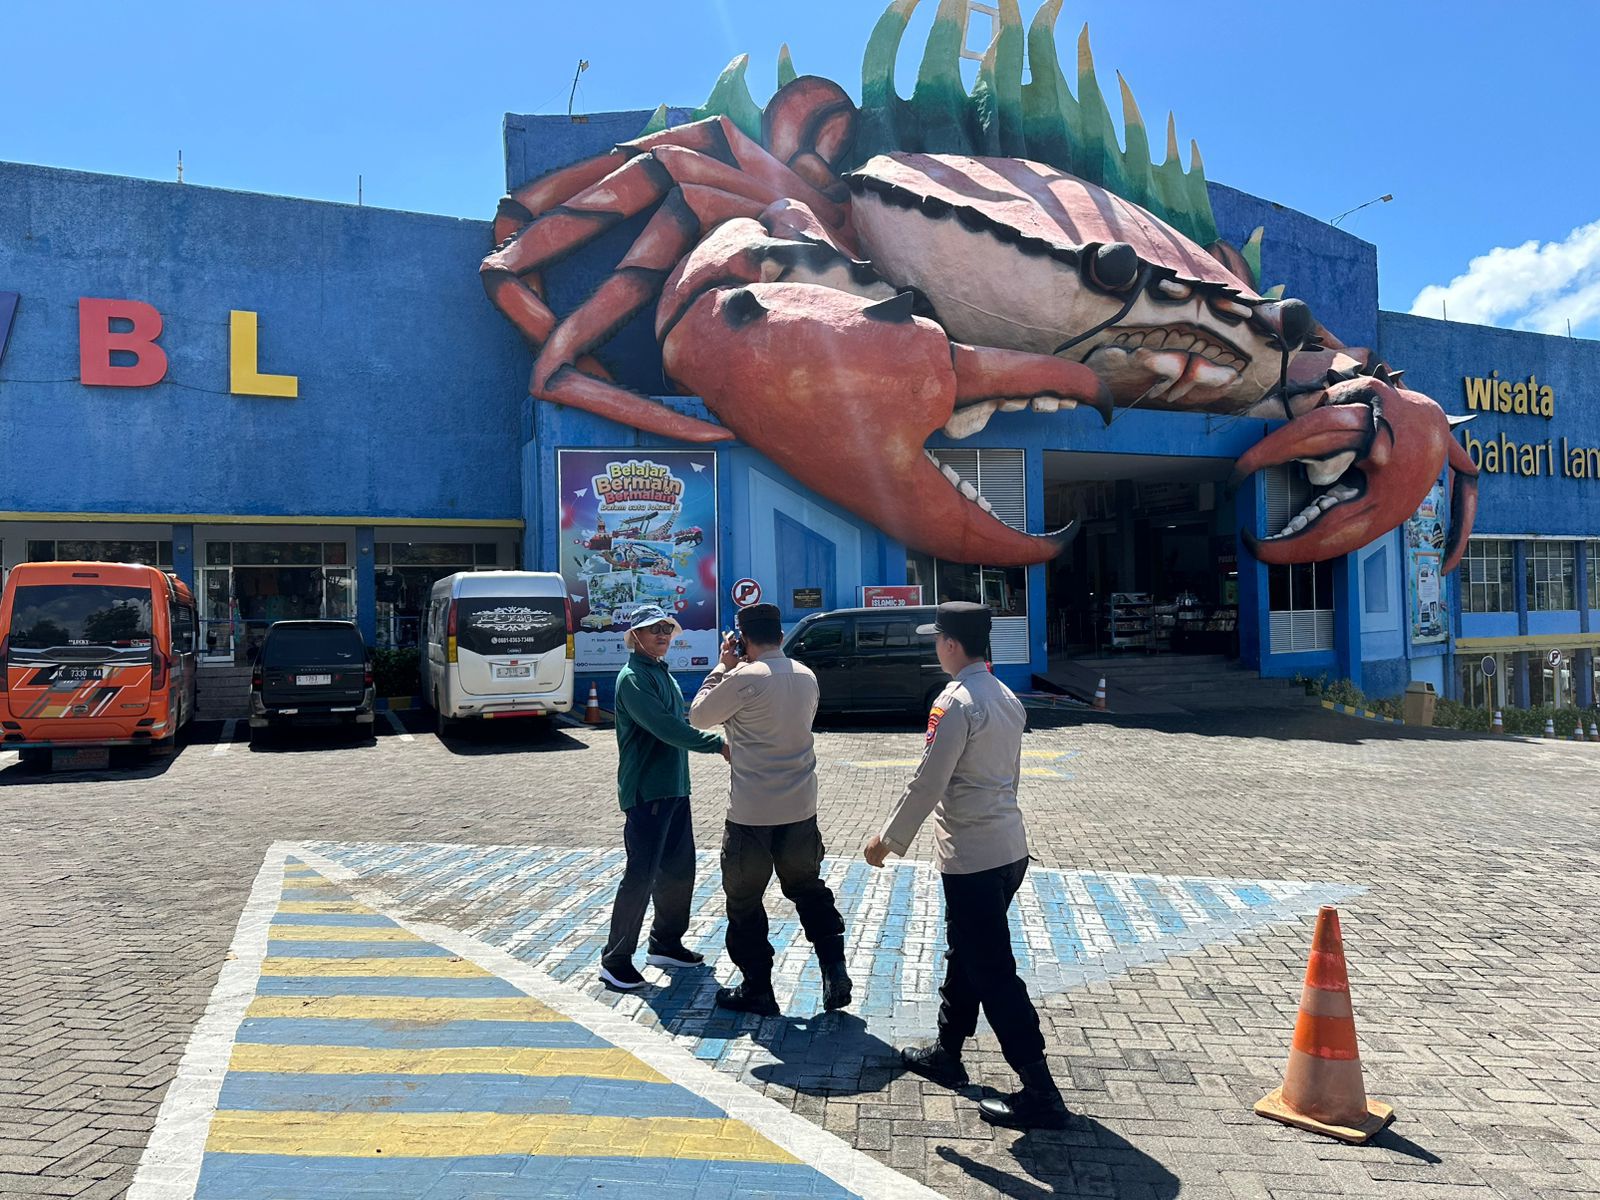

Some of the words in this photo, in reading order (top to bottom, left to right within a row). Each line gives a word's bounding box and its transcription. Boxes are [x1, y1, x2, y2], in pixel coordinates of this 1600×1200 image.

[1464, 369, 1554, 417] wisata
[1464, 429, 1554, 476] bahari
[610, 463, 666, 477] Belajar
[596, 476, 681, 495] Bermain
[872, 599, 897, 607] ISLAMIC
[58, 669, 64, 677] K
[71, 669, 88, 677] 7330
